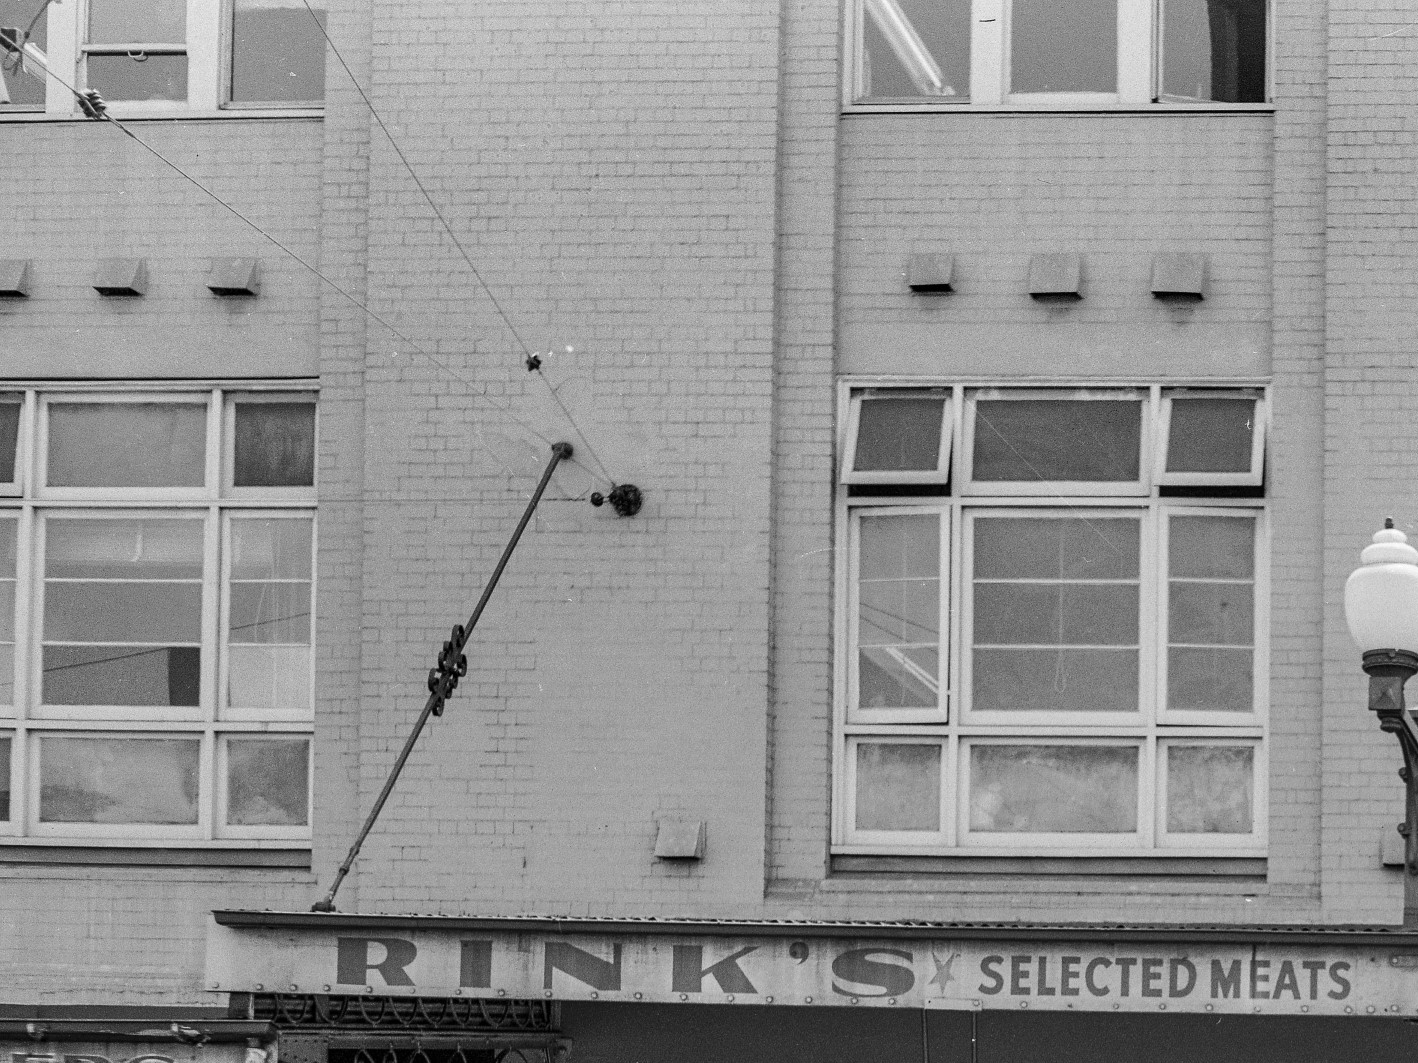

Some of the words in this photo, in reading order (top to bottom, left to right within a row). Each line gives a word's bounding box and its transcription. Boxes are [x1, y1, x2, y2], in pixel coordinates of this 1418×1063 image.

[336, 936, 915, 999] RINK'S
[978, 954, 1197, 997] SELECTED
[1209, 959, 1352, 1001] MEATS
